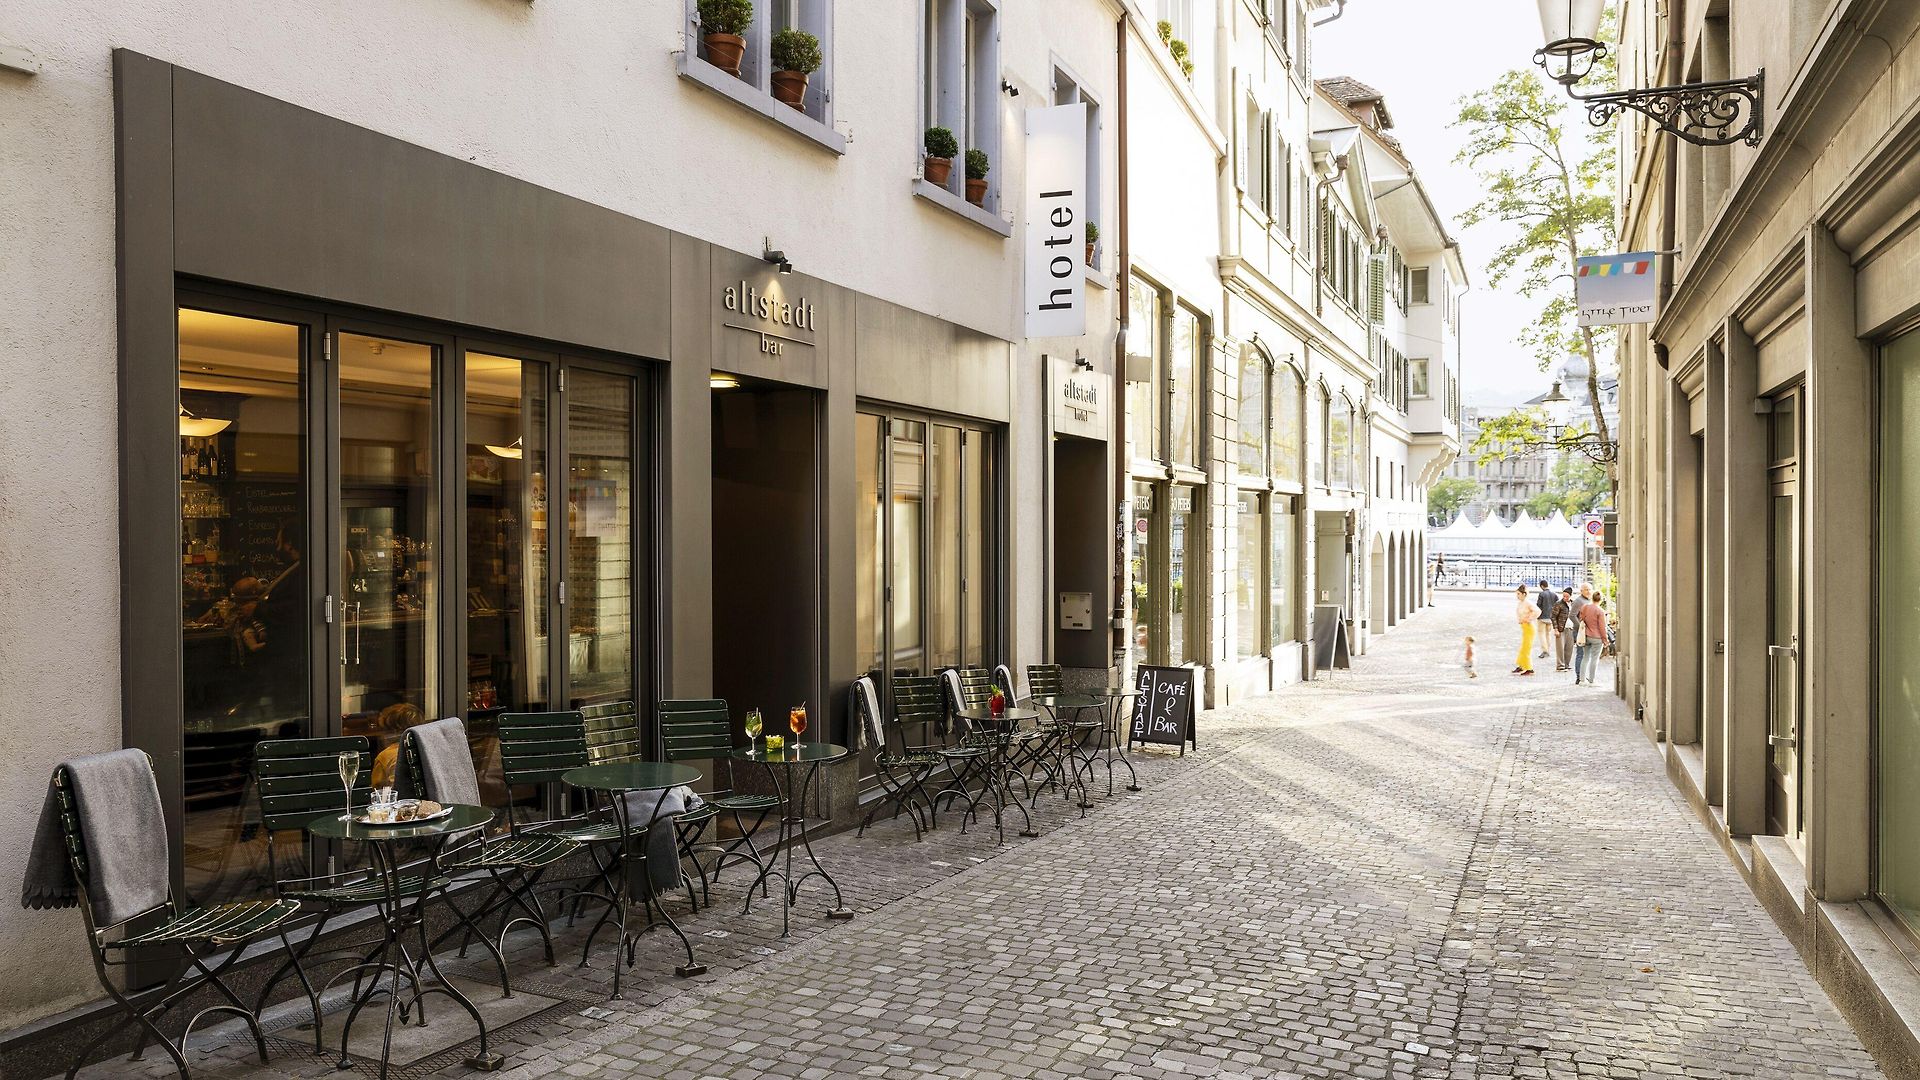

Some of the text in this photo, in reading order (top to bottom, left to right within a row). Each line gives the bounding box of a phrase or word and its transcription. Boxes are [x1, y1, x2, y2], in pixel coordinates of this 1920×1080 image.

[1039, 190, 1073, 311] hotel
[724, 280, 815, 331] altstadt
[760, 332, 784, 356] bar
[1063, 378, 1097, 405] altstadt
[1158, 681, 1187, 696] CAFÉ
[1134, 670, 1151, 738] ALTSTADT
[1154, 715, 1178, 735] BAR
